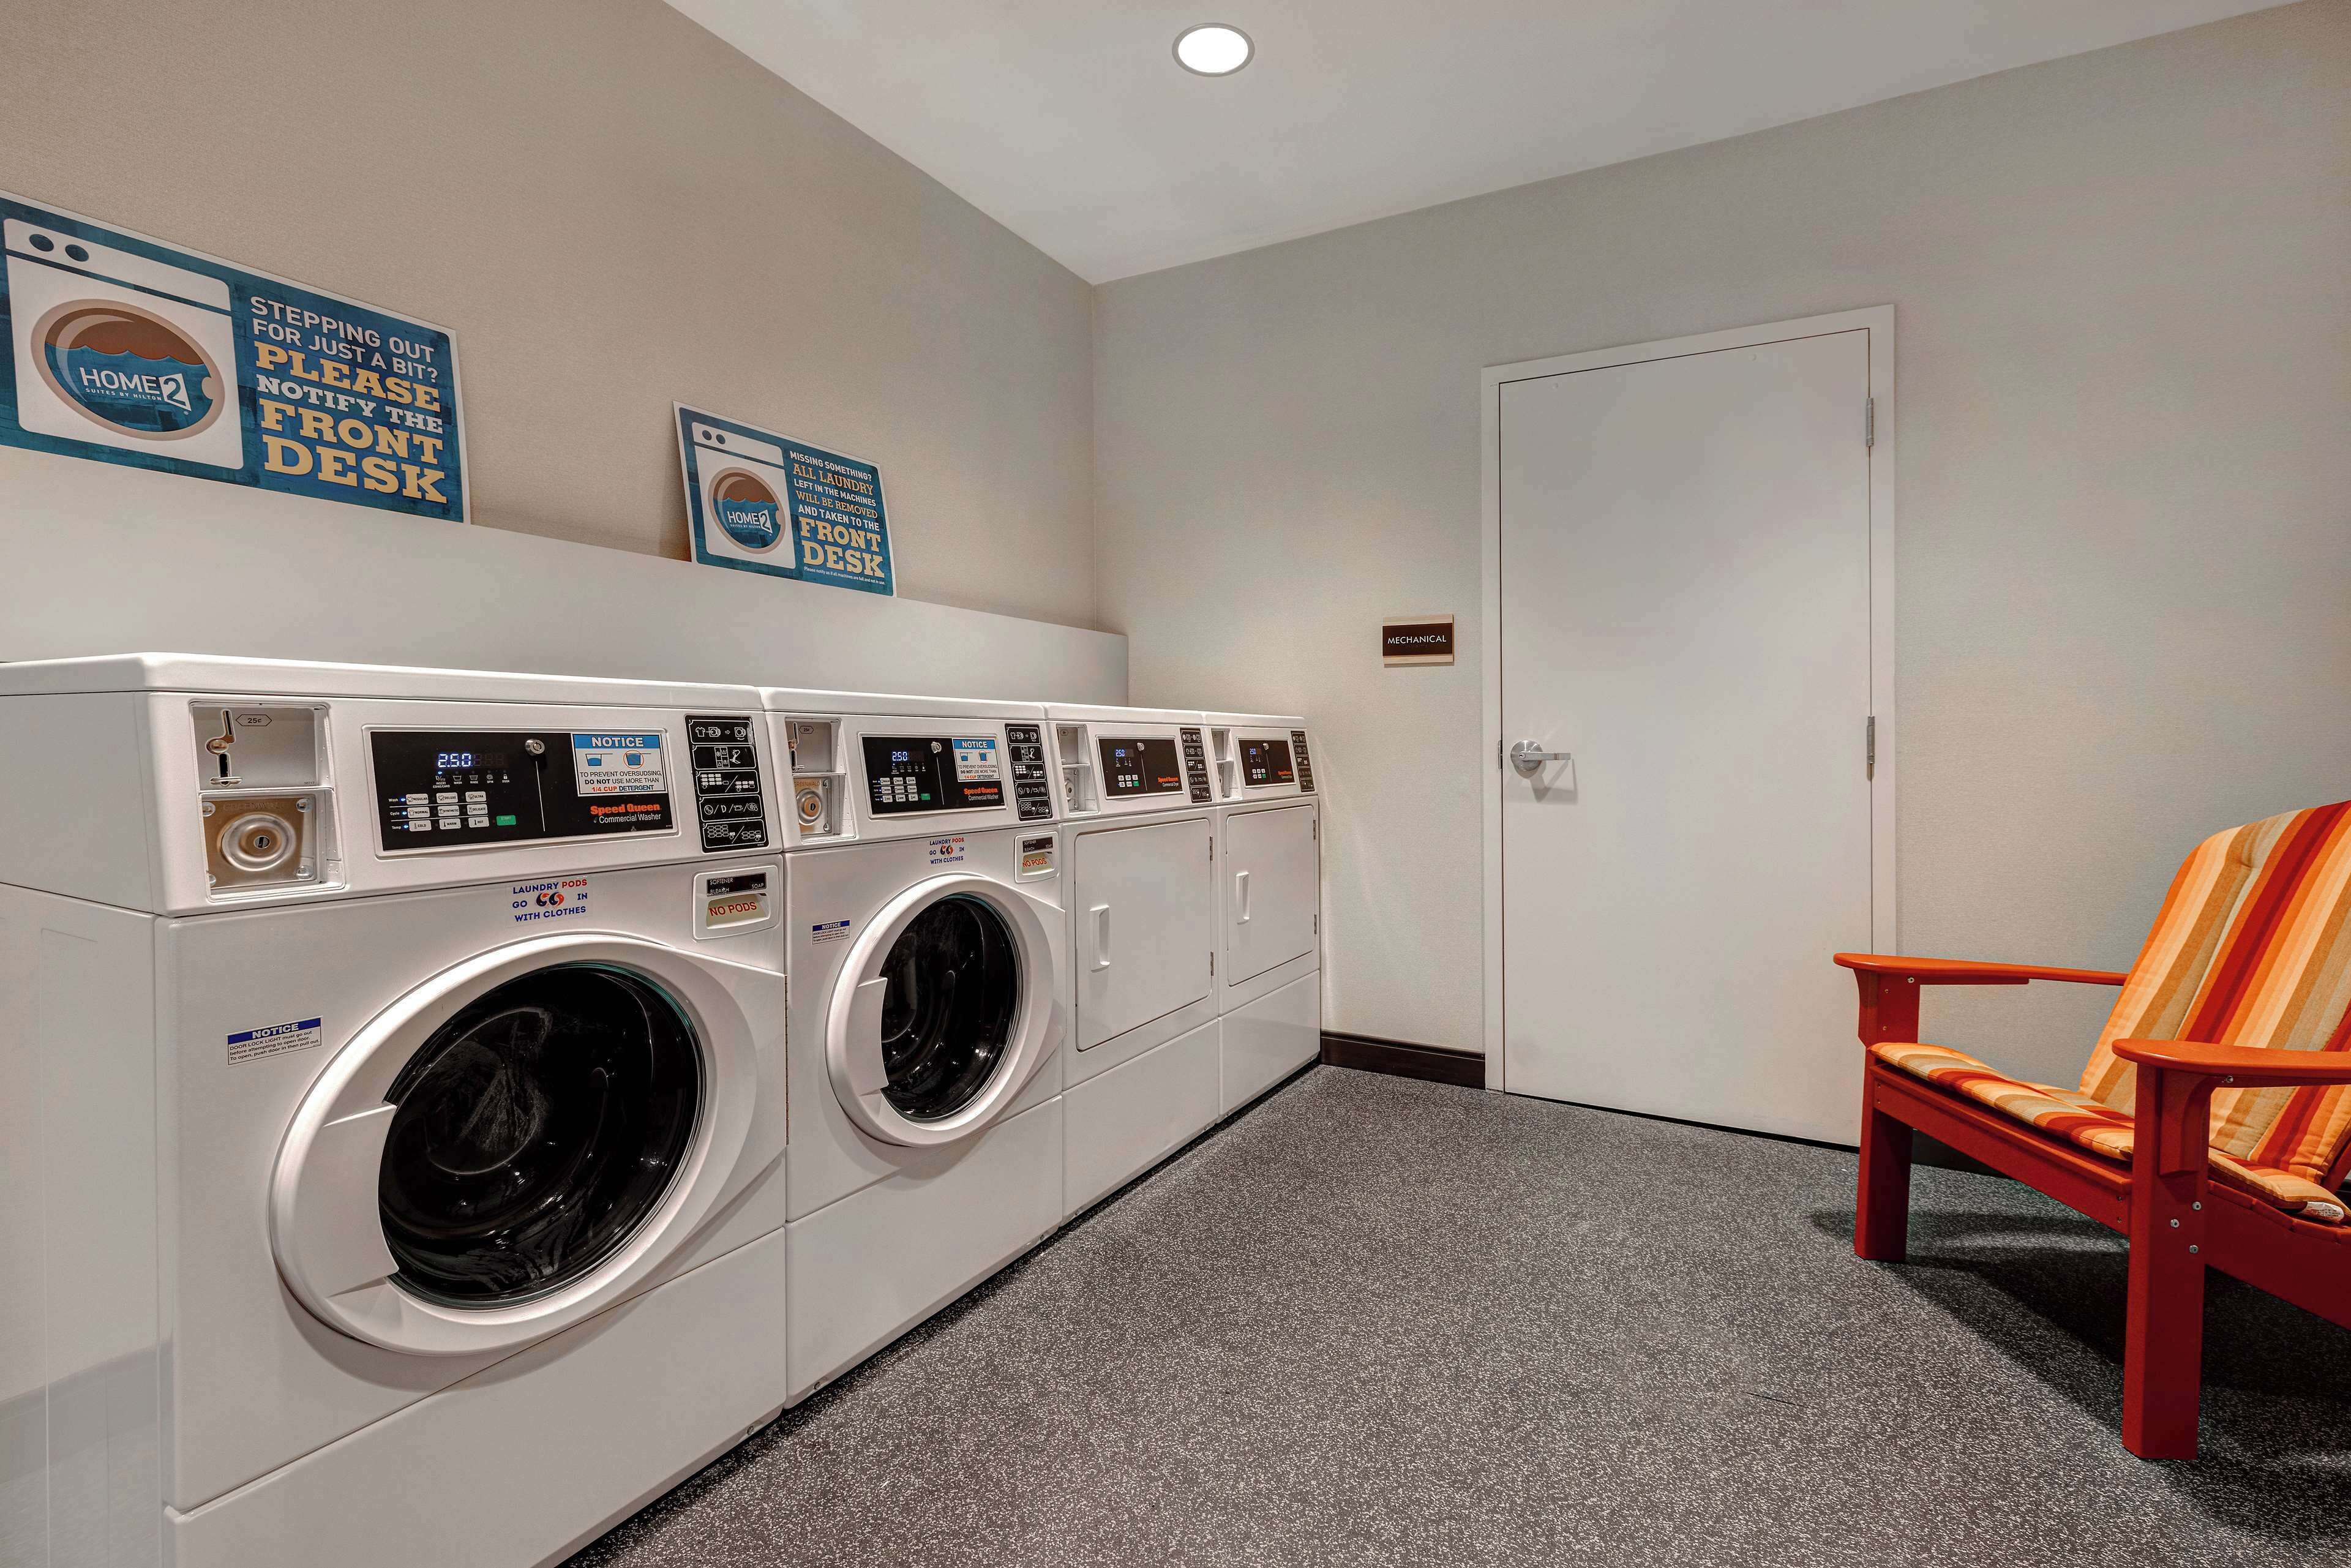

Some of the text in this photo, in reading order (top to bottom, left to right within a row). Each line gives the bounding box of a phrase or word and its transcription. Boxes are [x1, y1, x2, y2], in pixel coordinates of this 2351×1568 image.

[250, 296, 435, 363] STEPPING OUT
[253, 318, 438, 383] FOR JUST A BIT?
[254, 340, 441, 412] PLEASE
[256, 374, 443, 434] NOTIFY THE
[260, 398, 443, 465] FRONT
[263, 434, 448, 504] DESK
[789, 451, 872, 481] MISSING SOMETHING?
[793, 463, 874, 495] ALL LAUNDRY
[793, 478, 876, 506] LEFT IN THE MACHINES
[796, 490, 878, 519] WILL BE REMOVED
[798, 505, 880, 531] AND TAKEN TO THE
[798, 517, 881, 552] FRONT
[801, 540, 885, 578] DESK
[1387, 635, 1447, 644] MECHANICAL
[591, 737, 644, 747] NOTICE
[438, 753, 472, 768] 2.50
[893, 752, 908, 761] 2.50
[590, 803, 661, 816] Speed Queen
[599, 813, 661, 823] Commercial Washer
[513, 879, 588, 894] LAUNDRY PODS
[514, 906, 586, 922] WITH CLOTHES
[709, 902, 757, 917] NO PODS
[252, 1023, 299, 1039] NOTICE
[248, 1043, 276, 1052] attempting
